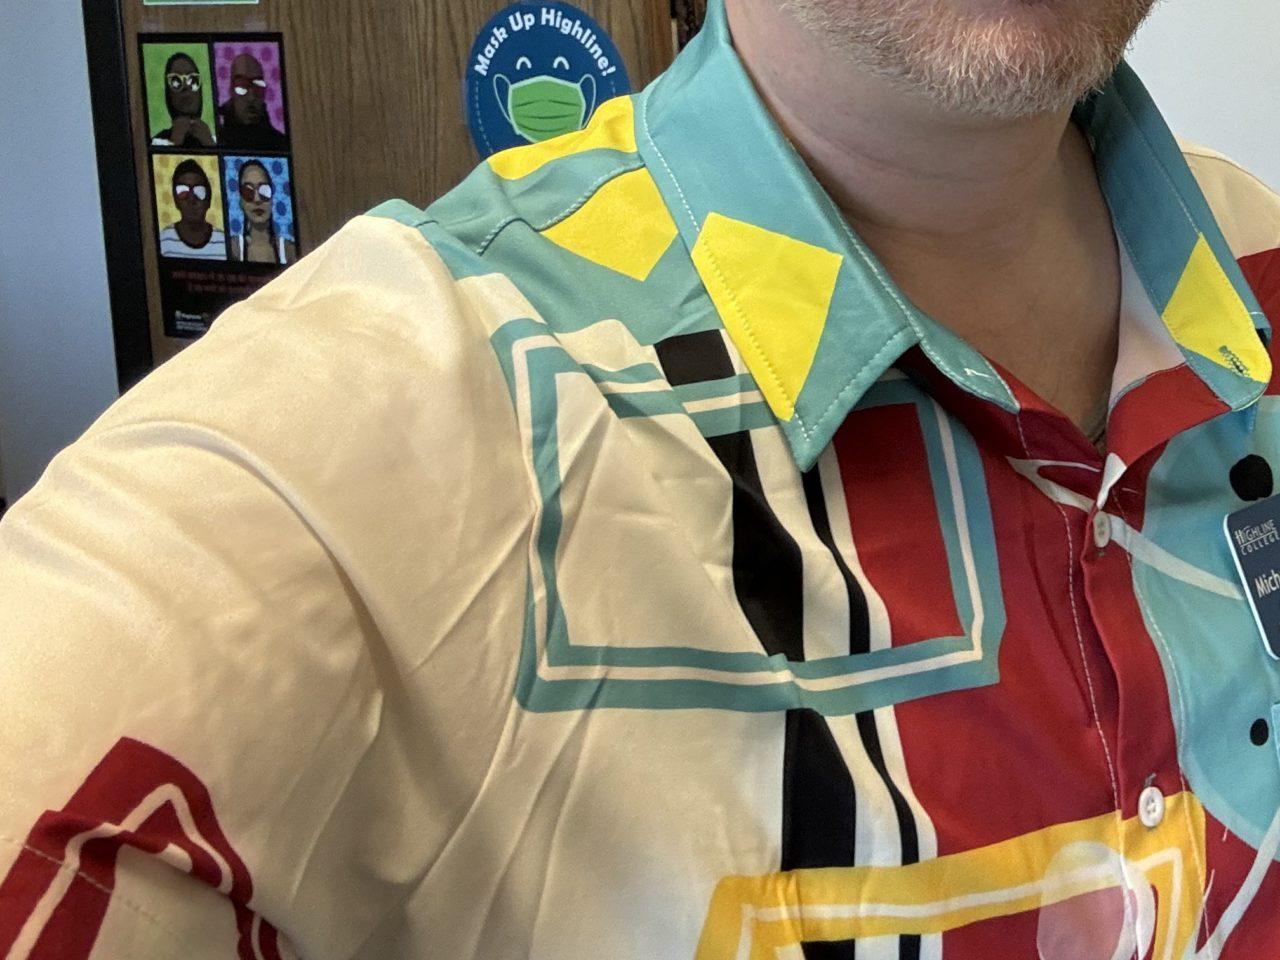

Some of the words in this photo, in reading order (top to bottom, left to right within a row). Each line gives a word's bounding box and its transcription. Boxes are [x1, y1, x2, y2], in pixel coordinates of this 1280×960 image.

[474, 26, 508, 76] Mask
[508, 11, 535, 32] Up
[541, 7, 616, 77] Highline!
[1234, 519, 1277, 545] HIGHLINE
[1240, 530, 1280, 556] COLLEGE
